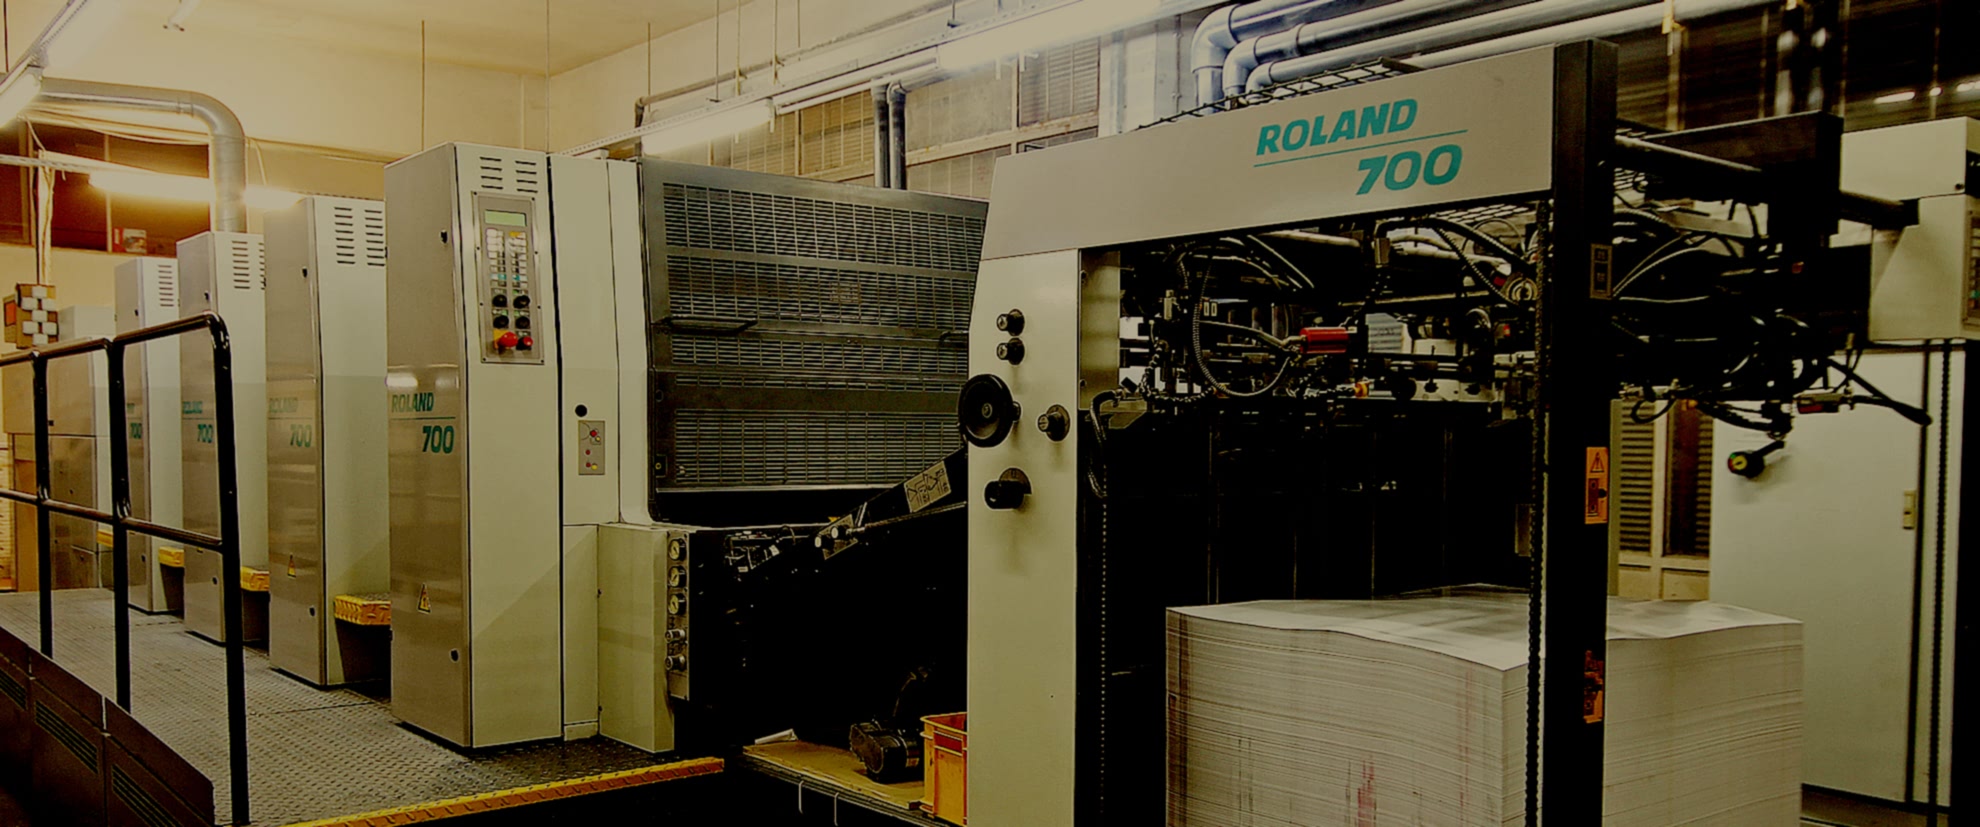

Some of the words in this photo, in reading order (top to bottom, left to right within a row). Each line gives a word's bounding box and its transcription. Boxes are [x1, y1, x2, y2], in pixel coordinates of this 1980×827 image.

[1256, 98, 1418, 156] ROLAND
[1355, 143, 1463, 195] 700
[391, 392, 435, 413] ROLAND
[290, 423, 312, 448] 700
[422, 425, 455, 454] 700
